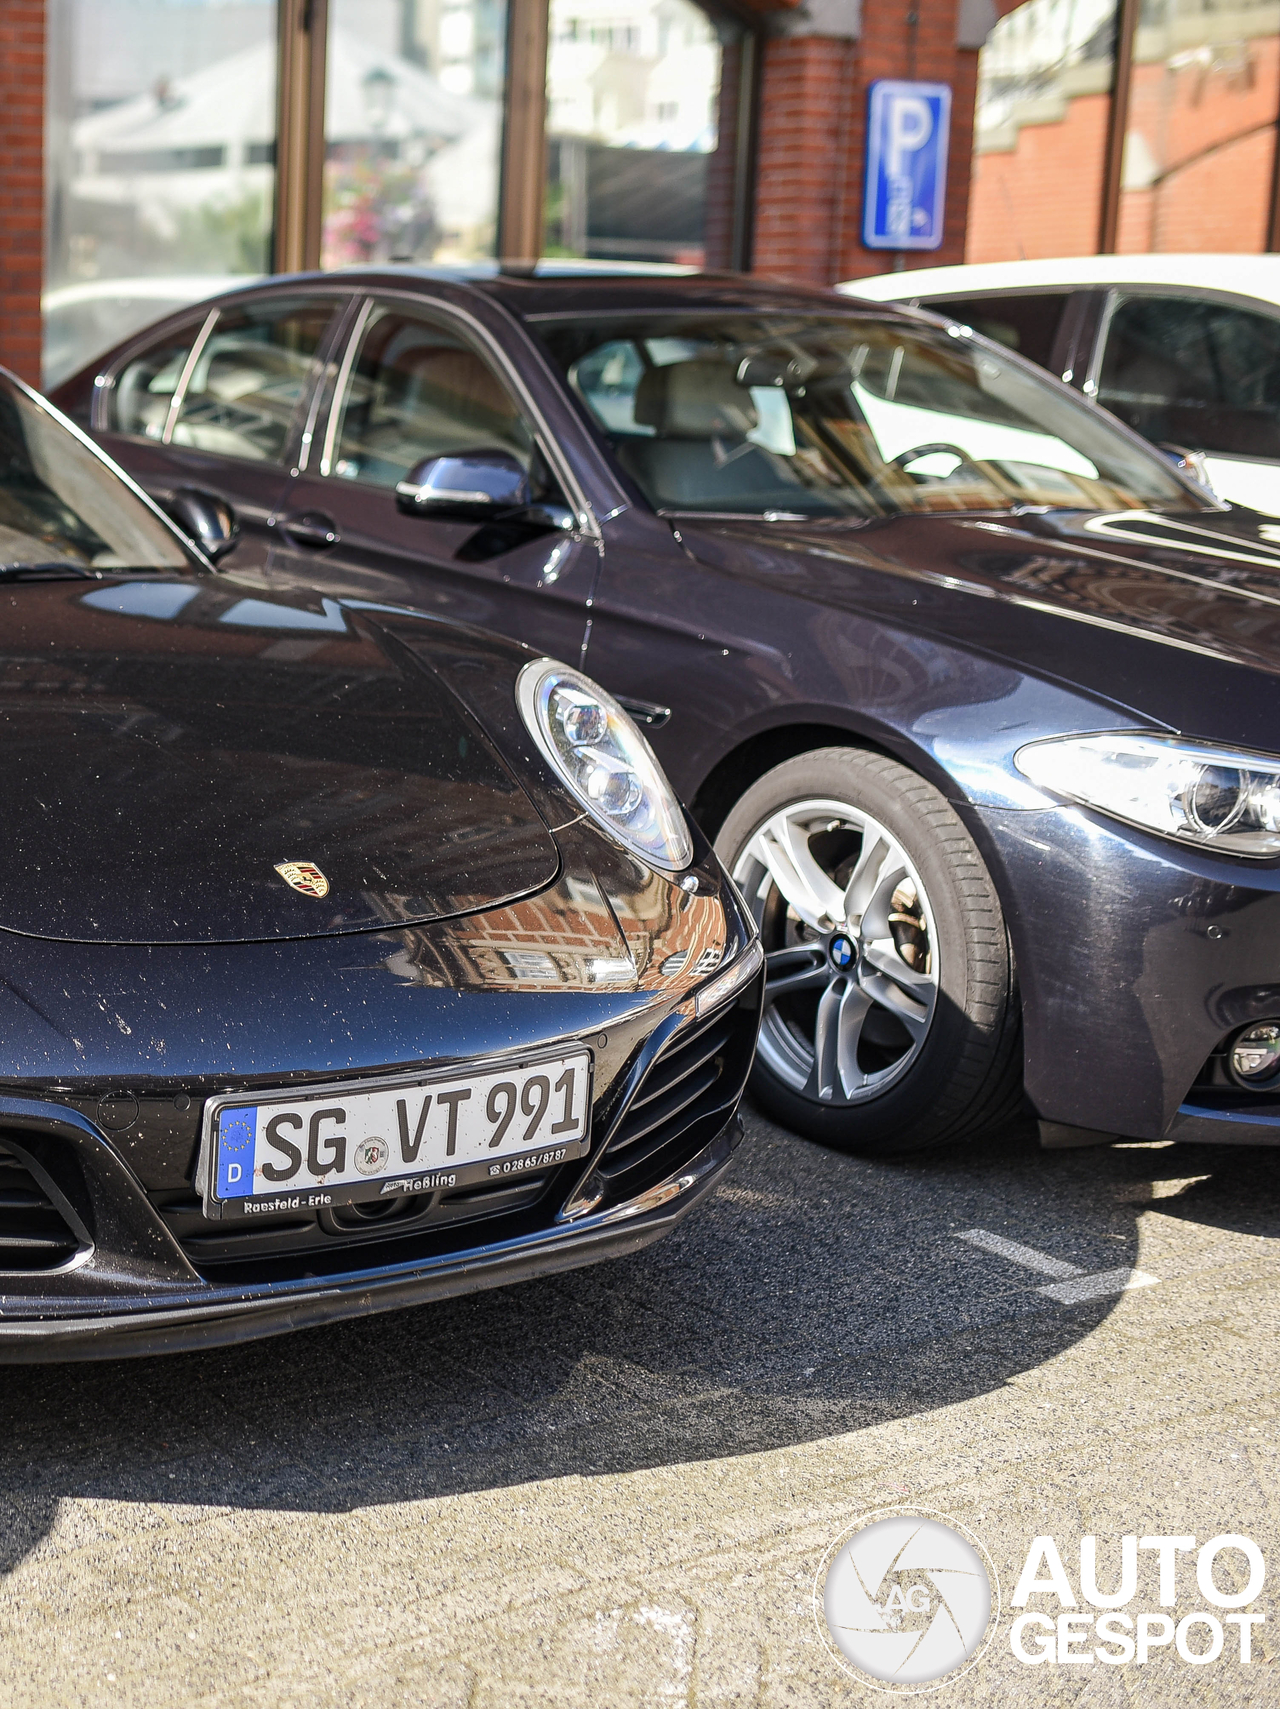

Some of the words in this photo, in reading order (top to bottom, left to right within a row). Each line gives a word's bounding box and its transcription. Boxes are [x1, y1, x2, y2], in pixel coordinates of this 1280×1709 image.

[886, 98, 933, 177] P
[262, 1108, 346, 1181] SG
[397, 1089, 471, 1163] VT
[486, 1068, 579, 1147] 991
[228, 1163, 241, 1182] D
